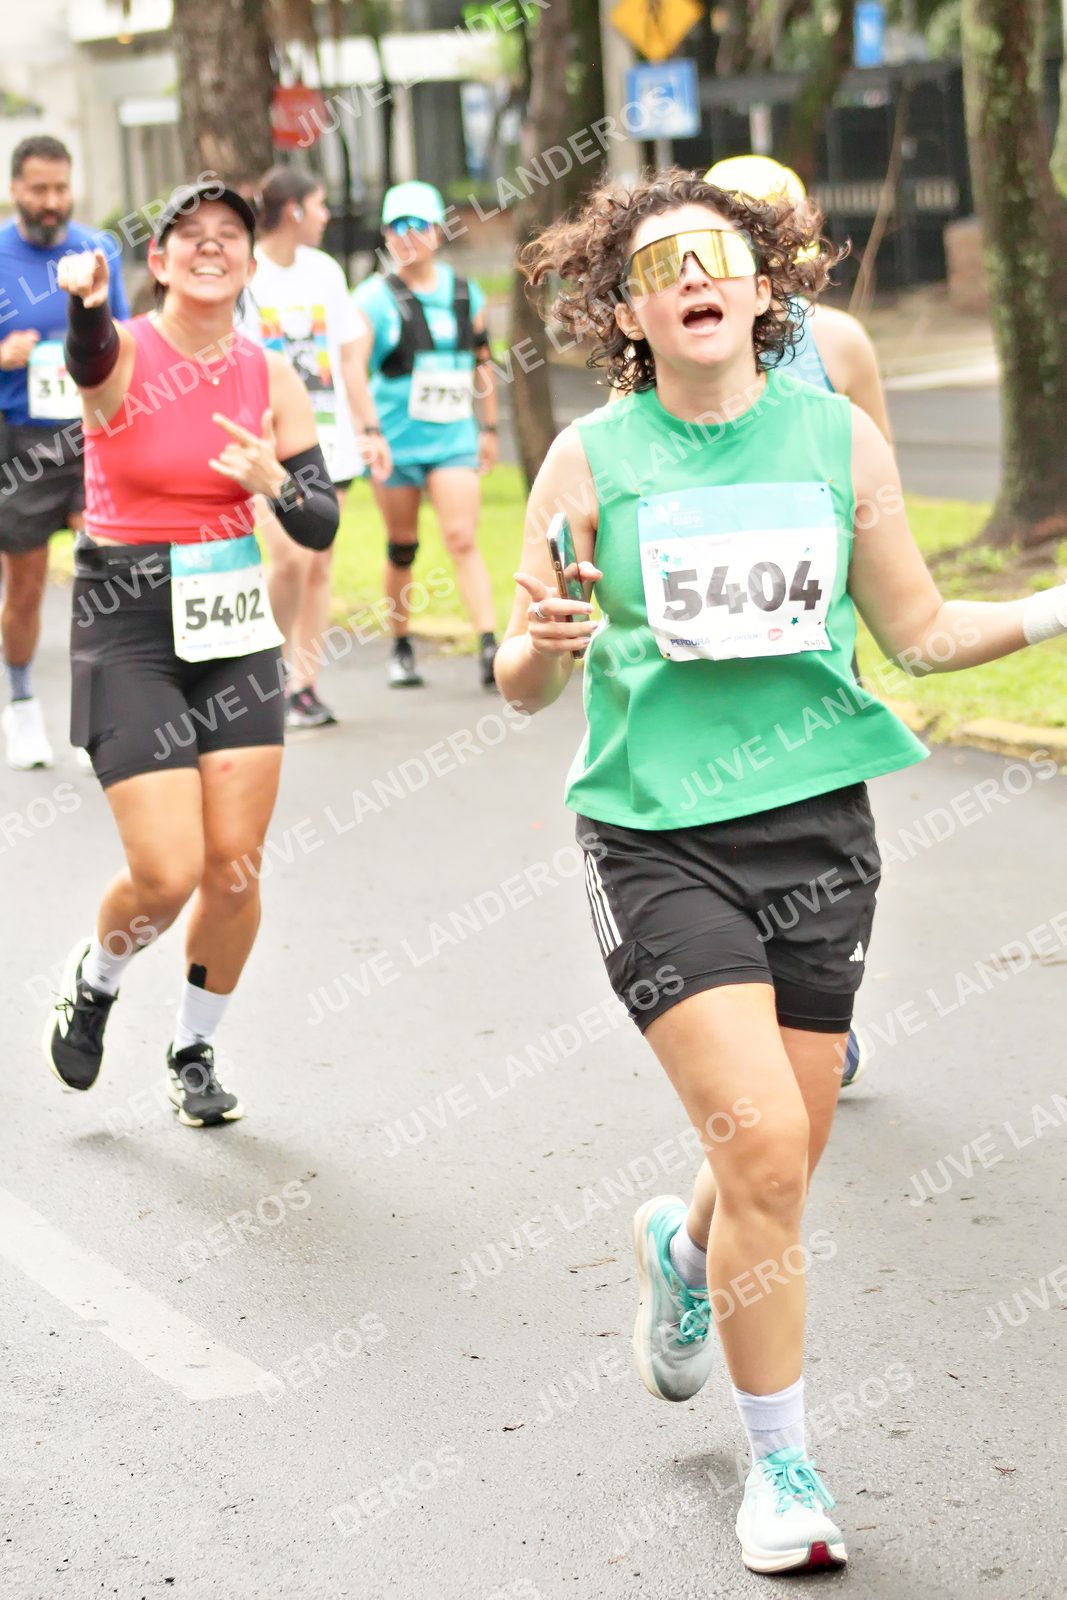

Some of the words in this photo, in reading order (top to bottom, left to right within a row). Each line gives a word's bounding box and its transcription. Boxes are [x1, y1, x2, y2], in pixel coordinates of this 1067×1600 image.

[38, 378, 80, 399] 31
[185, 587, 264, 631] 5402
[662, 560, 822, 621] 5404
